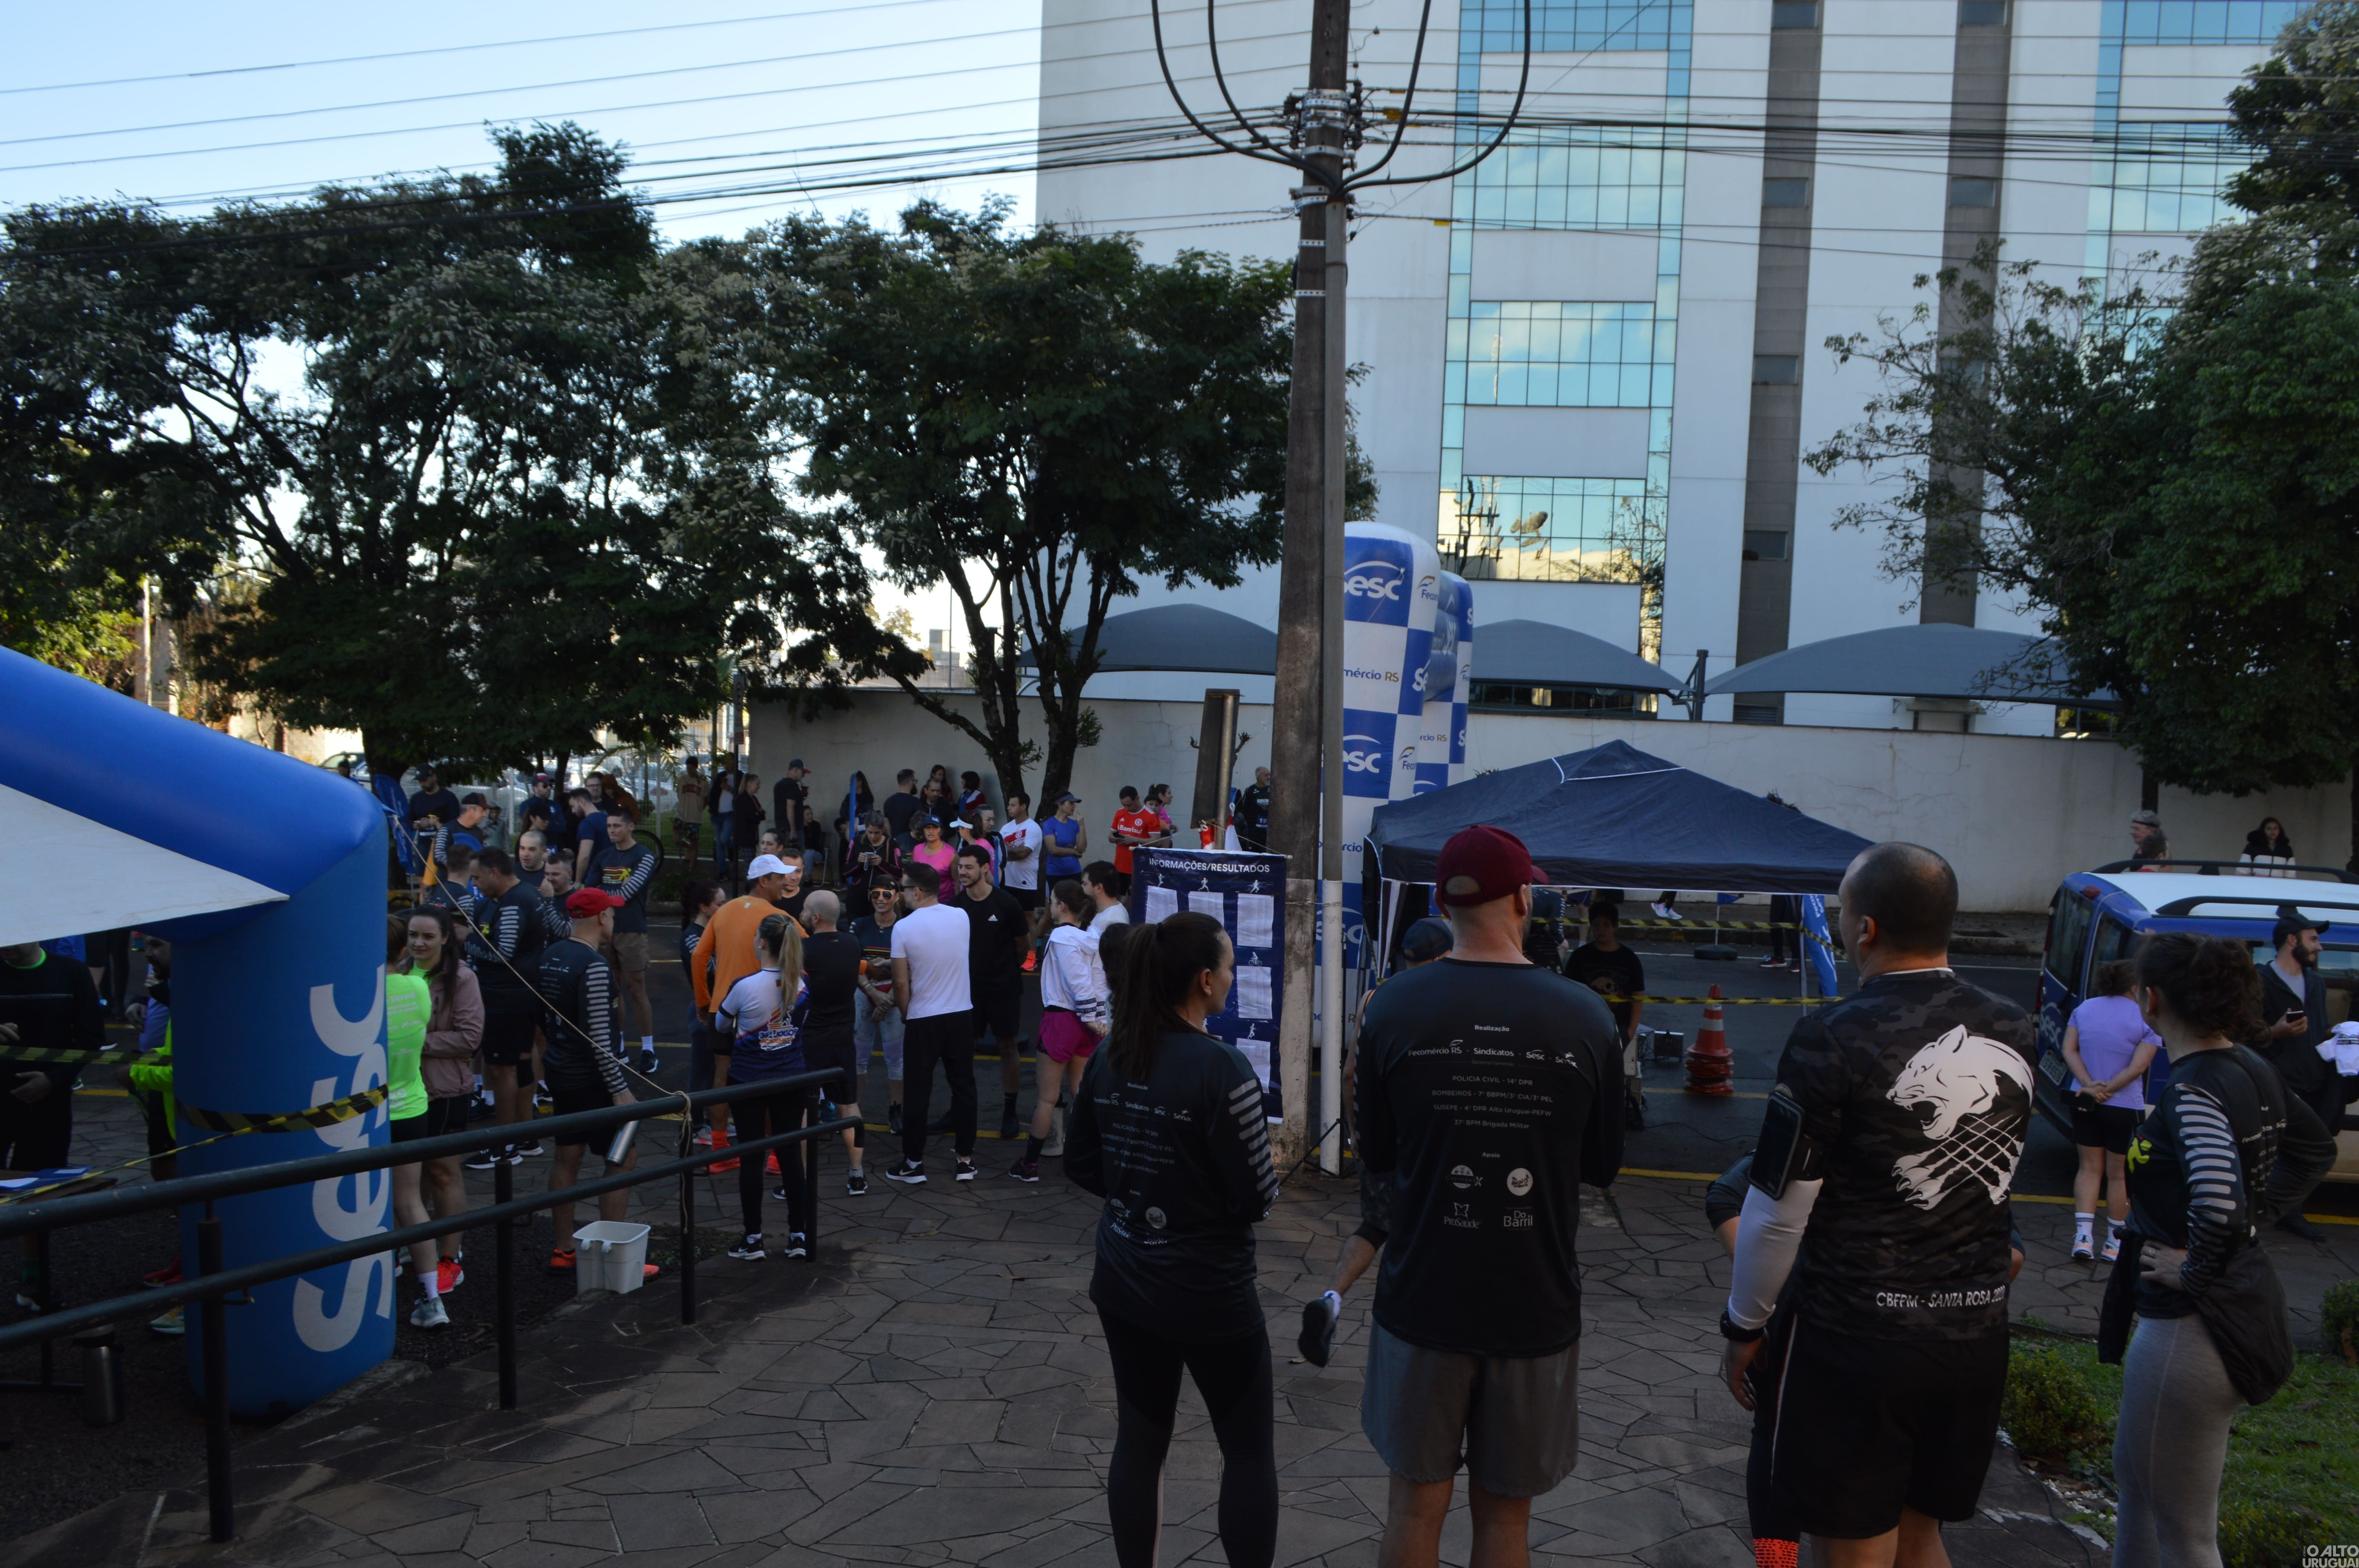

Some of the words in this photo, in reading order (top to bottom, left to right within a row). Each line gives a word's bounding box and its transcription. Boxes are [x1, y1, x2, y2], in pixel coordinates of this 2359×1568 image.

[1344, 575, 1401, 601] esc
[1385, 671, 1399, 682] RS
[1120, 824, 1143, 834] Banrisul
[1408, 1047, 1449, 1056] Fecomércio
[1474, 1047, 1514, 1056] Sindicatos
[1526, 1051, 1545, 1060] Sesc
[1503, 1214, 1533, 1227] Barril
[1514, 1210, 1526, 1219] Do
[1444, 1216, 1479, 1229] ProSaúde
[1876, 1292, 1919, 1307] CBFPM
[1928, 1292, 1963, 1308] SANTA
[1965, 1289, 1990, 1306] ROSA
